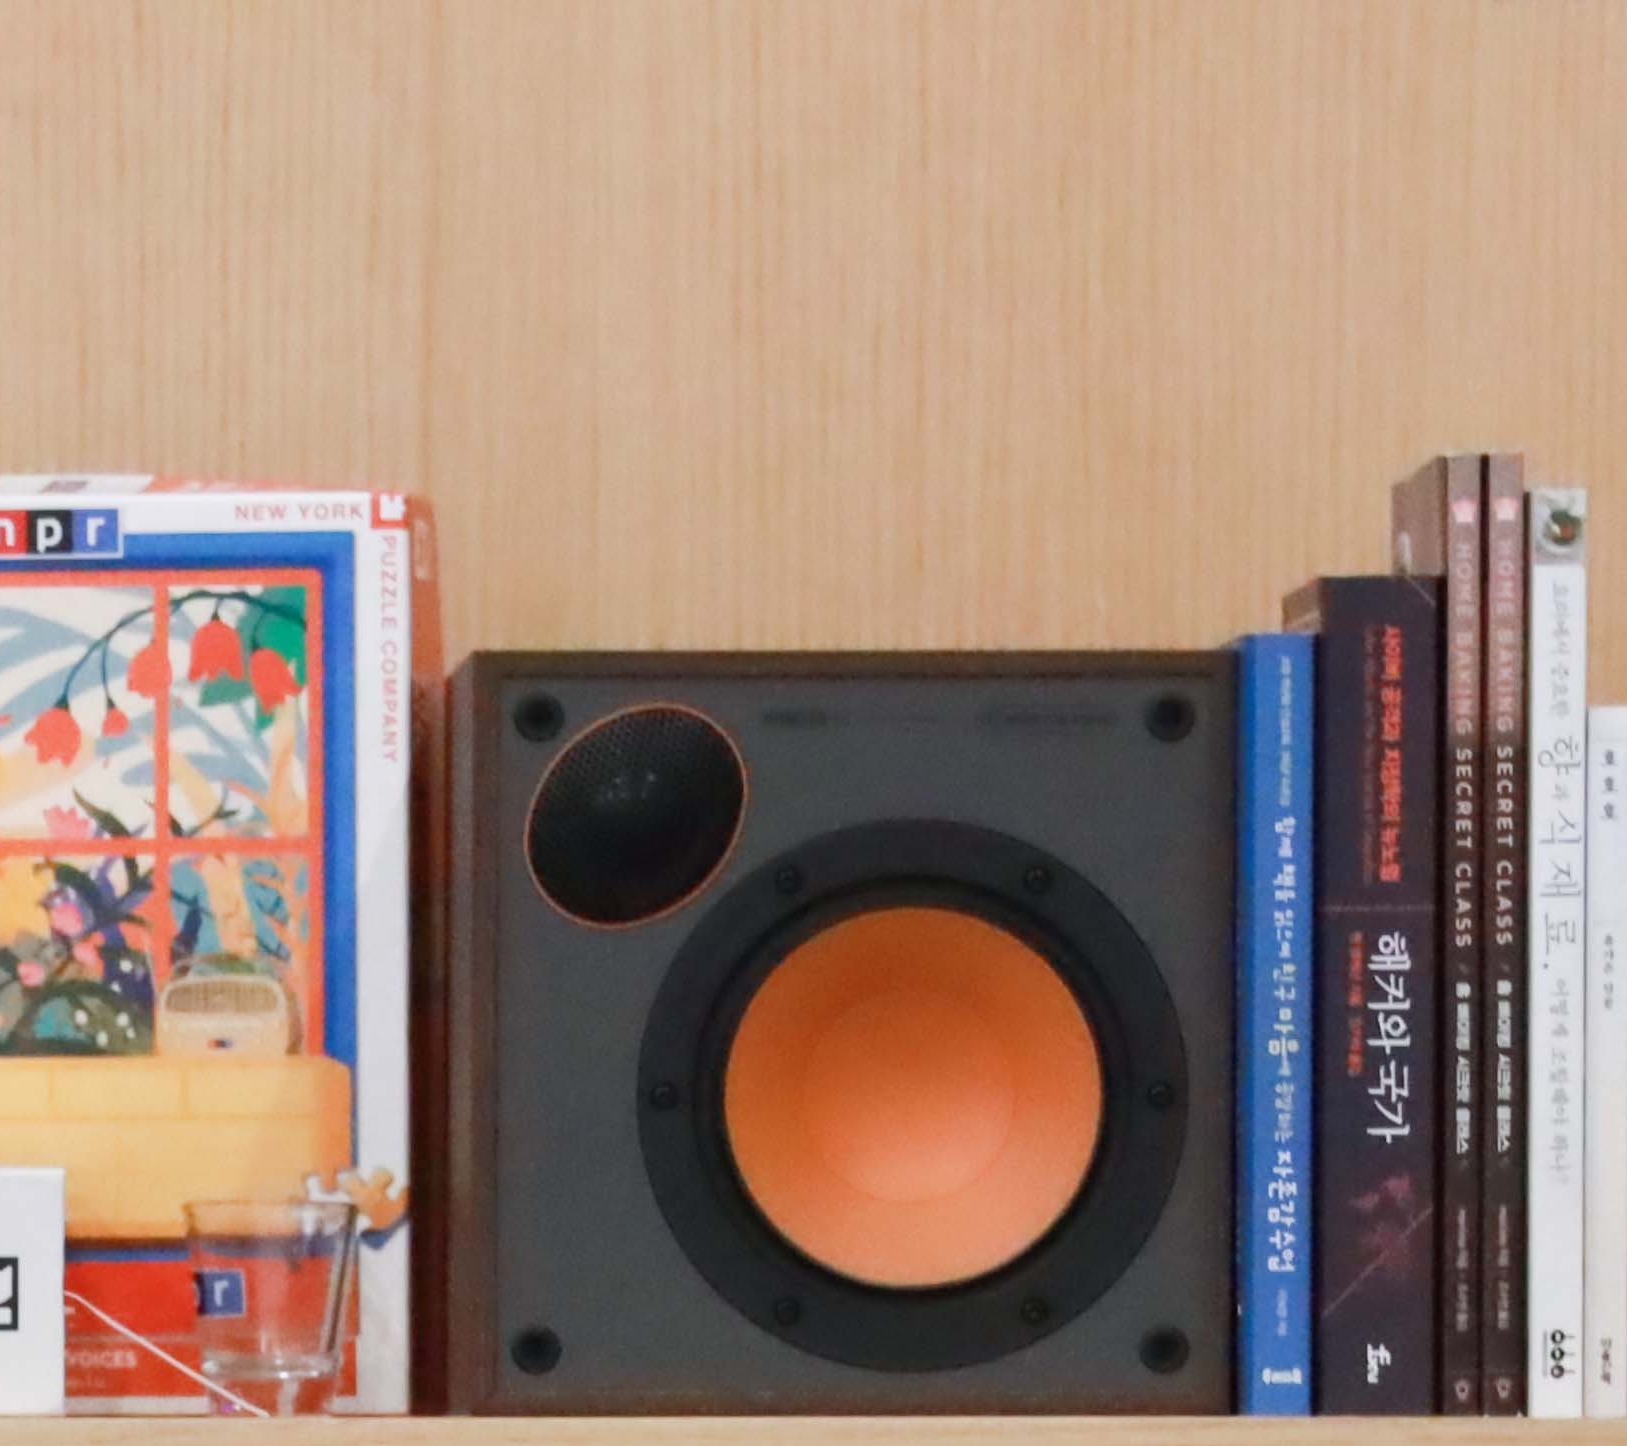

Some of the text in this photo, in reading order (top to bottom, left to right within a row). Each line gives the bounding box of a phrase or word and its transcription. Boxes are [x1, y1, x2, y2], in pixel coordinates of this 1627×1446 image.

[234, 502, 365, 521] NEW YORK
[378, 535, 398, 765] PUZZLE COMPANY
[1454, 543, 1474, 948] HOME BAKING SECRET CLASS
[1495, 538, 1514, 948] HOME BAKING SECRET CLASS
[1365, 931, 1413, 1144] 해커와 국가
